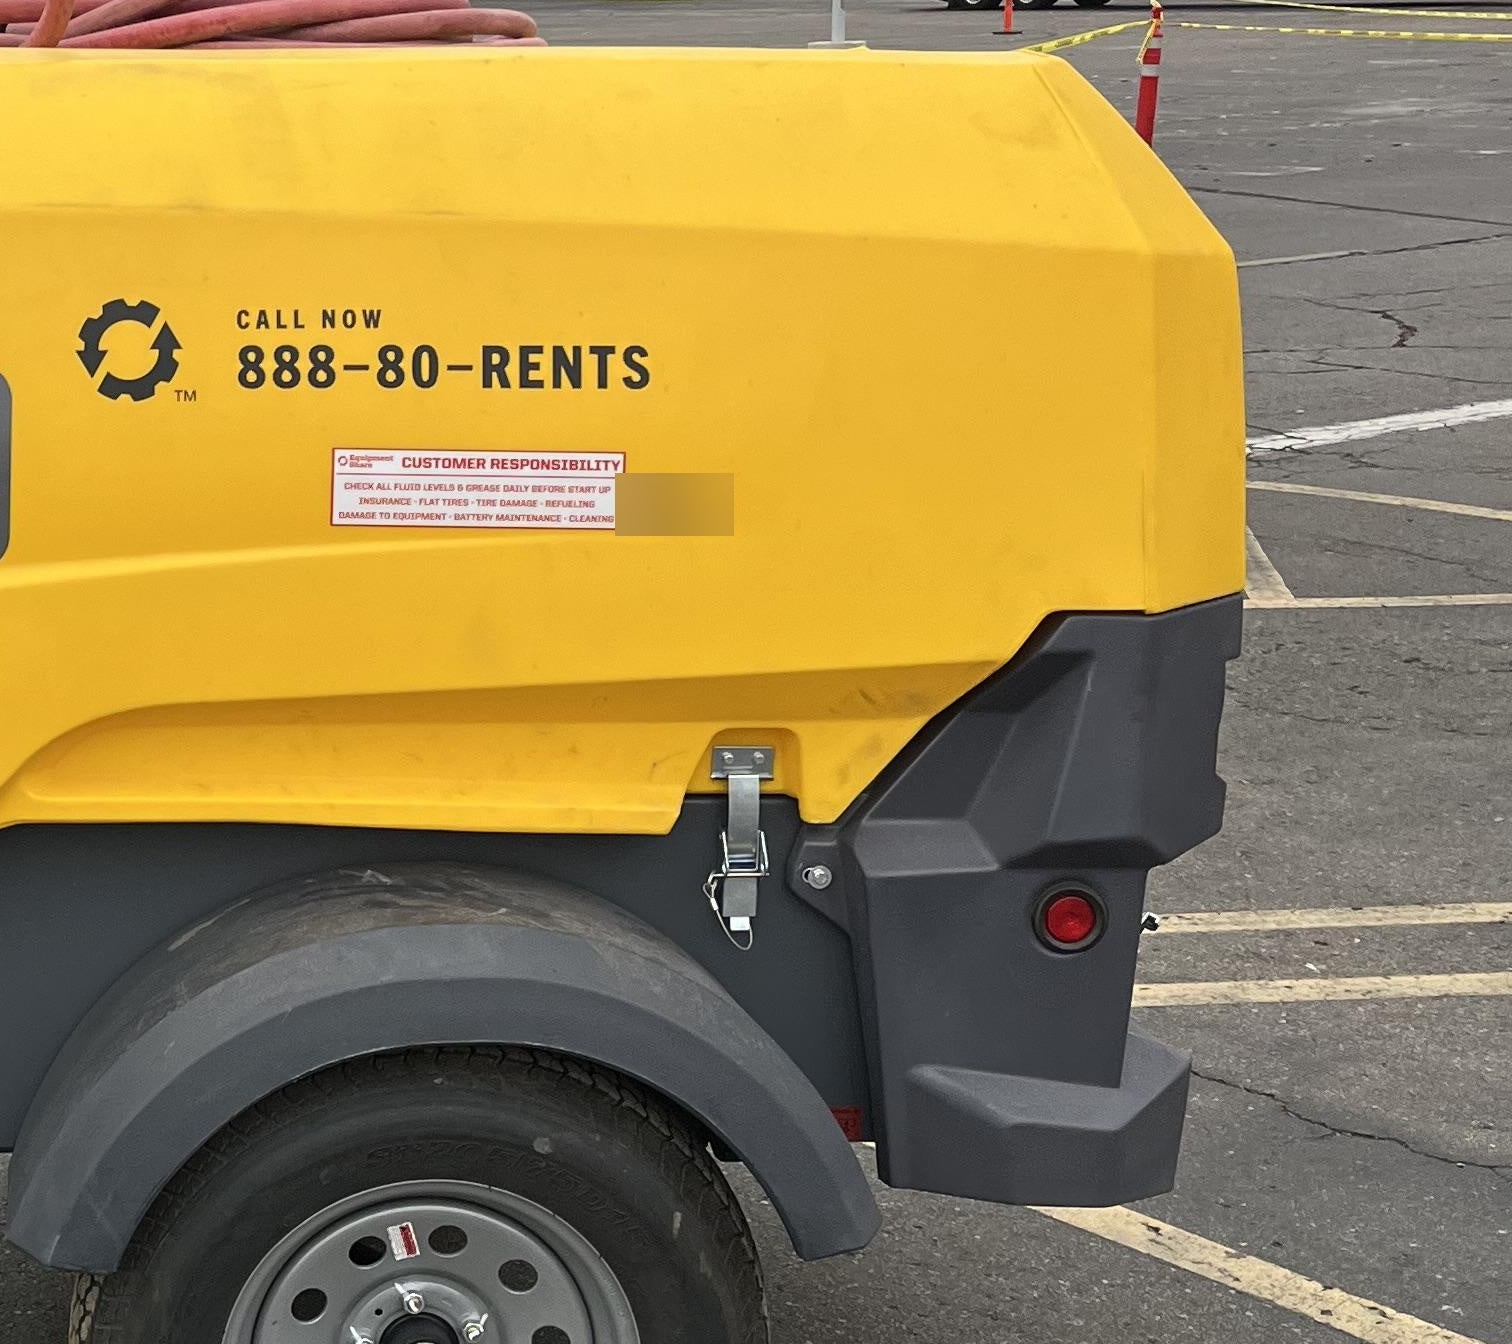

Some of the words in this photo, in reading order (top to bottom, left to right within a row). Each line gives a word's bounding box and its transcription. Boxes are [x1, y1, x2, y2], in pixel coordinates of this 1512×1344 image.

[236, 308, 305, 330] CALL
[322, 308, 382, 330] NOW
[237, 344, 651, 391] 888-80-RENTS
[349, 454, 394, 462] Equipment
[401, 456, 487, 470] CUSTOMER
[490, 458, 621, 472] RESPONSIBILITY
[343, 482, 374, 491] CHECK
[375, 482, 392, 491] ALL
[394, 483, 421, 491] FLUID
[423, 483, 455, 492] LEVELS
[465, 484, 501, 493] GREASE
[503, 484, 530, 493] DAILY
[531, 485, 566, 494] BEFORE
[568, 486, 597, 494] START
[598, 486, 611, 494] UP
[358, 496, 412, 506] INSURANCE
[419, 498, 440, 506] FLAT
[442, 498, 469, 507] TIRES
[476, 499, 497, 507] TIRE
[499, 499, 538, 508] DAMAGE
[545, 499, 595, 509] REFUELING
[338, 511, 377, 520] DAMAGE
[379, 512, 391, 520] TO
[392, 512, 447, 522] EQUIPMENT
[453, 513, 494, 522] BATTERY
[495, 514, 562, 523] MAINTENANCE
[568, 515, 615, 524] CLEANING
